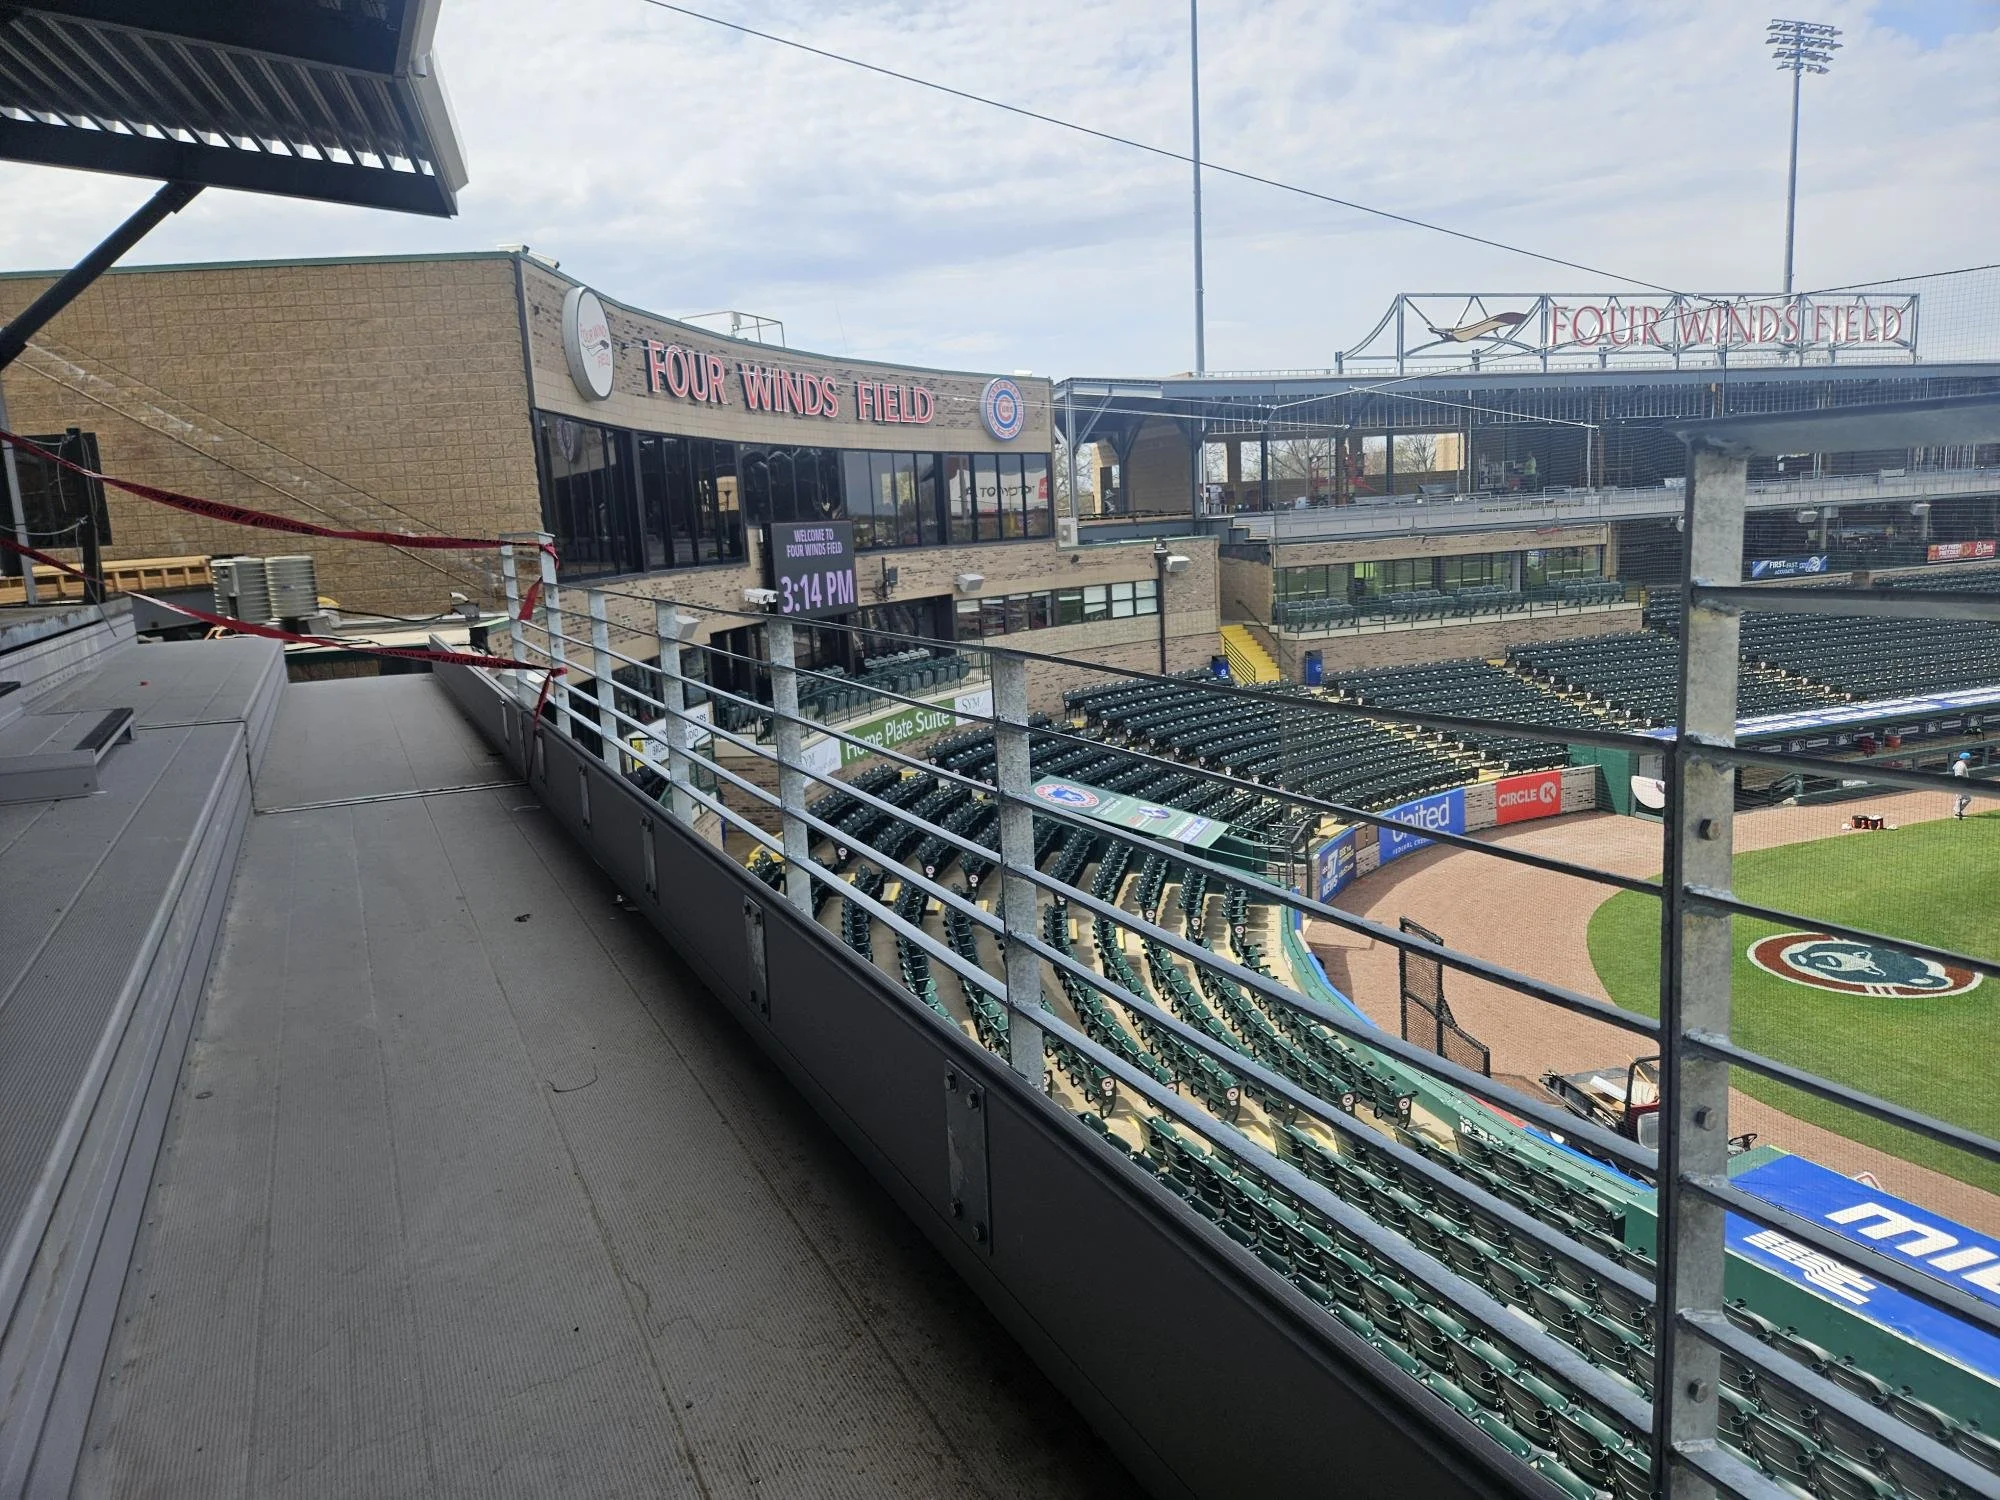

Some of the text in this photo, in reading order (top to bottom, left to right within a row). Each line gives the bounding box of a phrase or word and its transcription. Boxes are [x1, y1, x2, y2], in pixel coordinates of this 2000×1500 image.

[1551, 305, 1902, 345] FOUR WINDS FIELD
[648, 340, 934, 424] FOUR WINDS FIELD
[794, 528, 834, 543] WELCOME TO
[787, 541, 843, 558] FOUR WINDS FIELD
[781, 569, 854, 613] 3:14 PM
[885, 720, 913, 745] Plate
[915, 711, 950, 733] Suite
[1500, 789, 1537, 807] CIRCLE
[1392, 841, 1413, 855] FEDERAL
